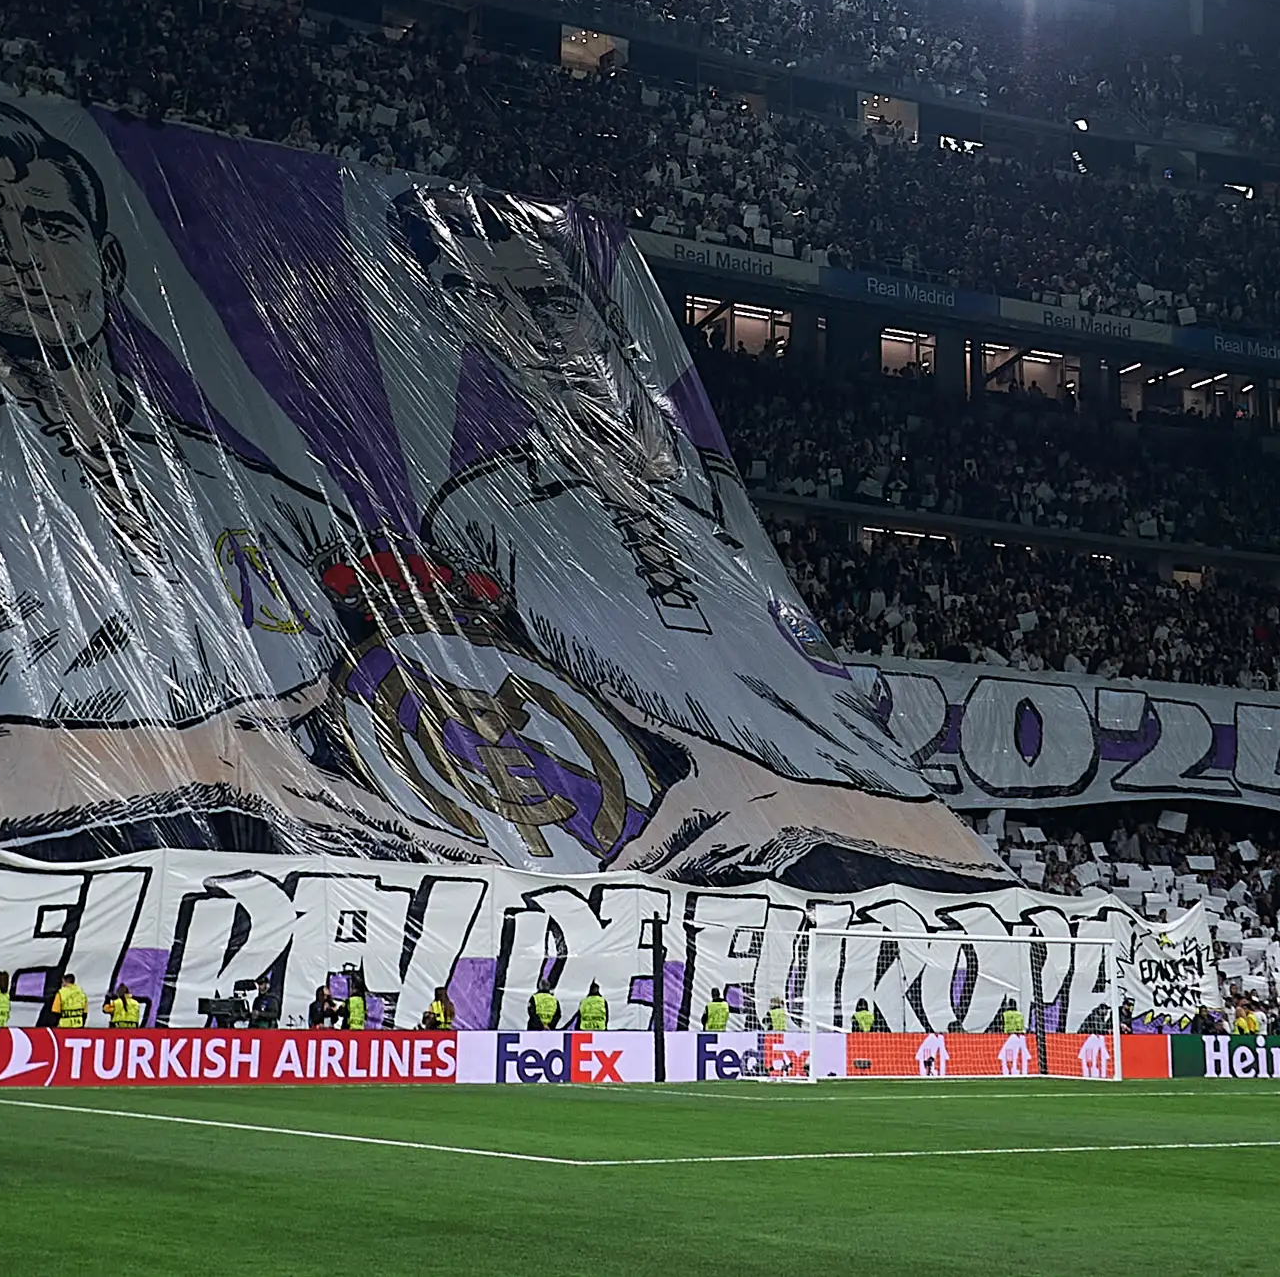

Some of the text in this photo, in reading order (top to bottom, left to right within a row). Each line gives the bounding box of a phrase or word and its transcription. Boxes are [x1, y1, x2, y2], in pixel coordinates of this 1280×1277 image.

[674, 244, 773, 276] Real Madrid
[867, 277, 955, 307] Real Madrid
[1043, 311, 1132, 339] Real Madrid
[1214, 336, 1245, 356] Real
[65, 1038, 456, 1080] TURKISH AIRLINES
[496, 1032, 623, 1083] FedEx
[697, 1033, 810, 1081] FedEx
